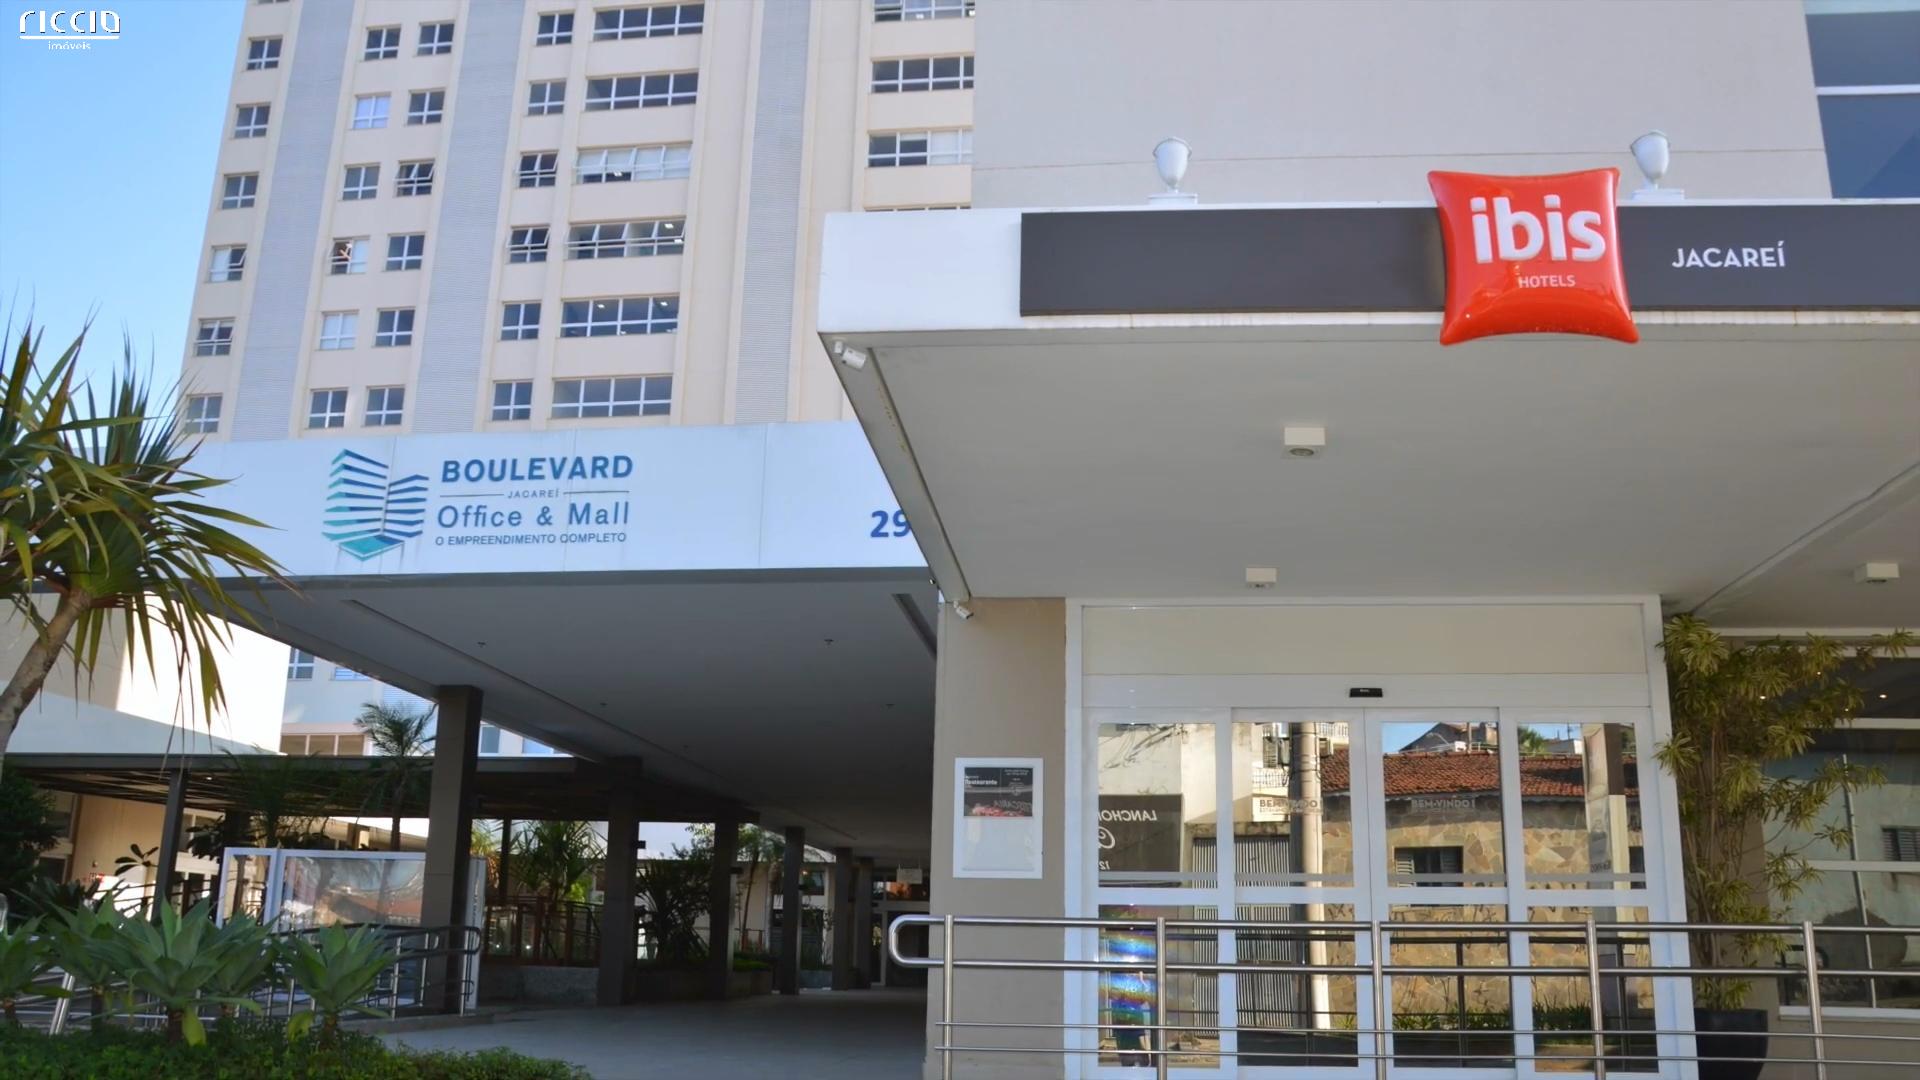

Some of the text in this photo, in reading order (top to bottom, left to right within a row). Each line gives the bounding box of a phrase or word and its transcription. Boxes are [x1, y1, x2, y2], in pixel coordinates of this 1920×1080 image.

[1470, 194, 1606, 264] ibis
[1671, 240, 1786, 268] JACAREÍ
[1518, 274, 1576, 289] HOTELS
[441, 455, 634, 483] BOULEVARD
[437, 501, 630, 528] Office & Mall
[435, 532, 627, 546] O EMPREENDIMENTO COMPLETO
